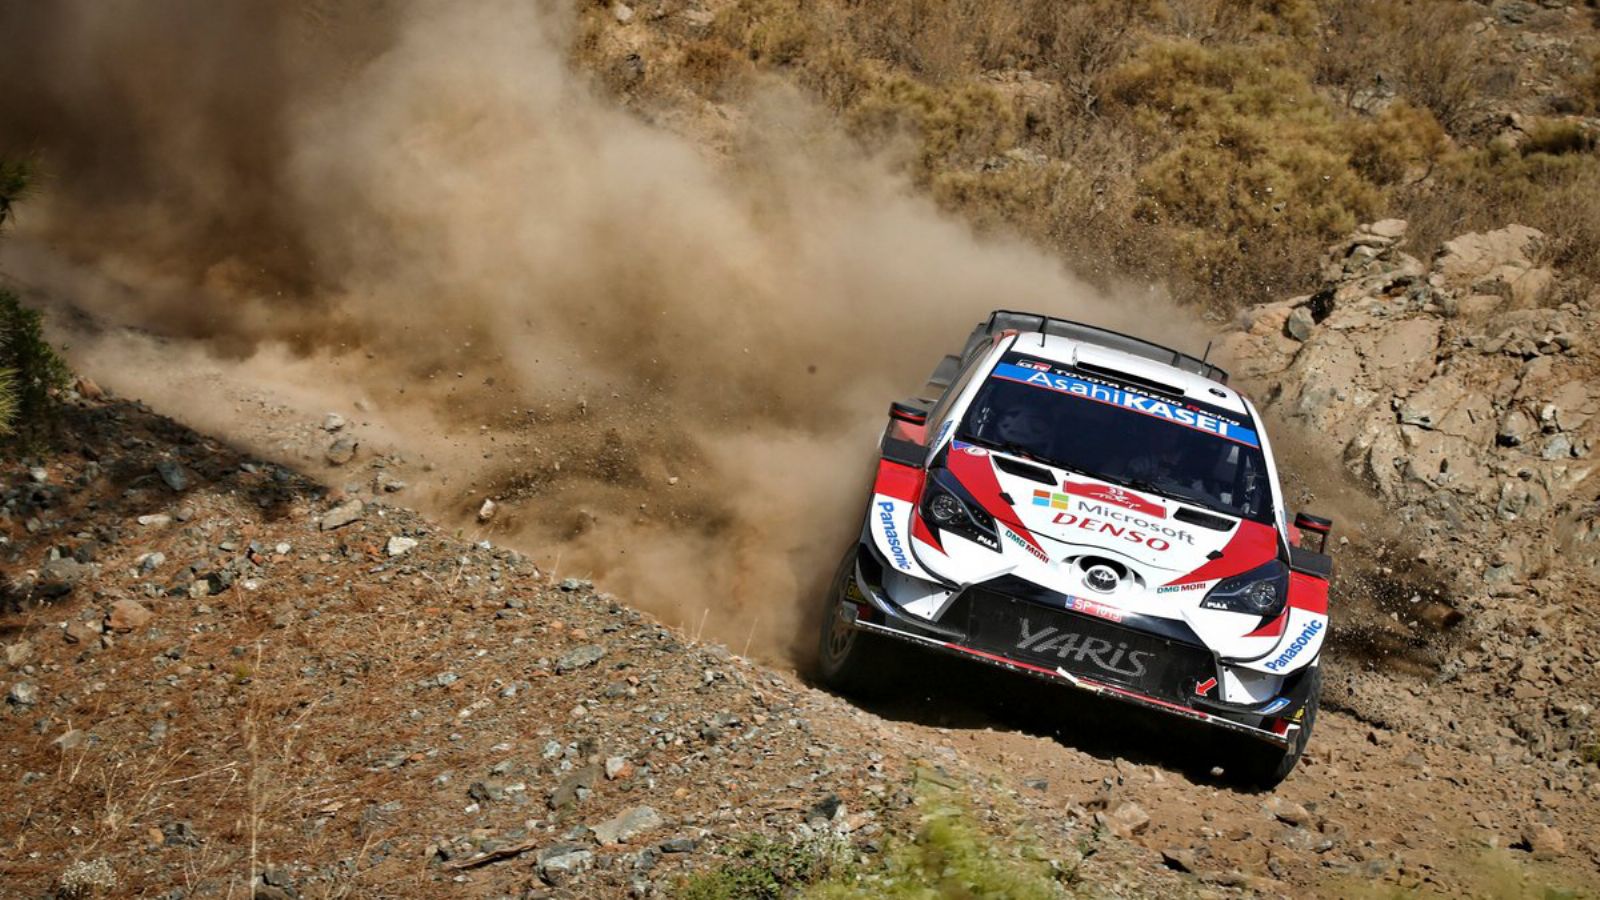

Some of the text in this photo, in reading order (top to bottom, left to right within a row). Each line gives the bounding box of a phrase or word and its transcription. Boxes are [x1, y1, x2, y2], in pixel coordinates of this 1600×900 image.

[1055, 369, 1120, 389] TOYOTA
[878, 500, 912, 570] Panasonic
[1052, 512, 1170, 551] DENSO
[1078, 501, 1195, 545] Microsoft
[977, 535, 998, 548] PIAA
[1005, 529, 1050, 564] DMG MORI
[1157, 583, 1206, 594] DMG MORI
[1074, 599, 1092, 611] SP
[1207, 601, 1228, 610] PIAA
[1265, 619, 1323, 671] Panasonic
